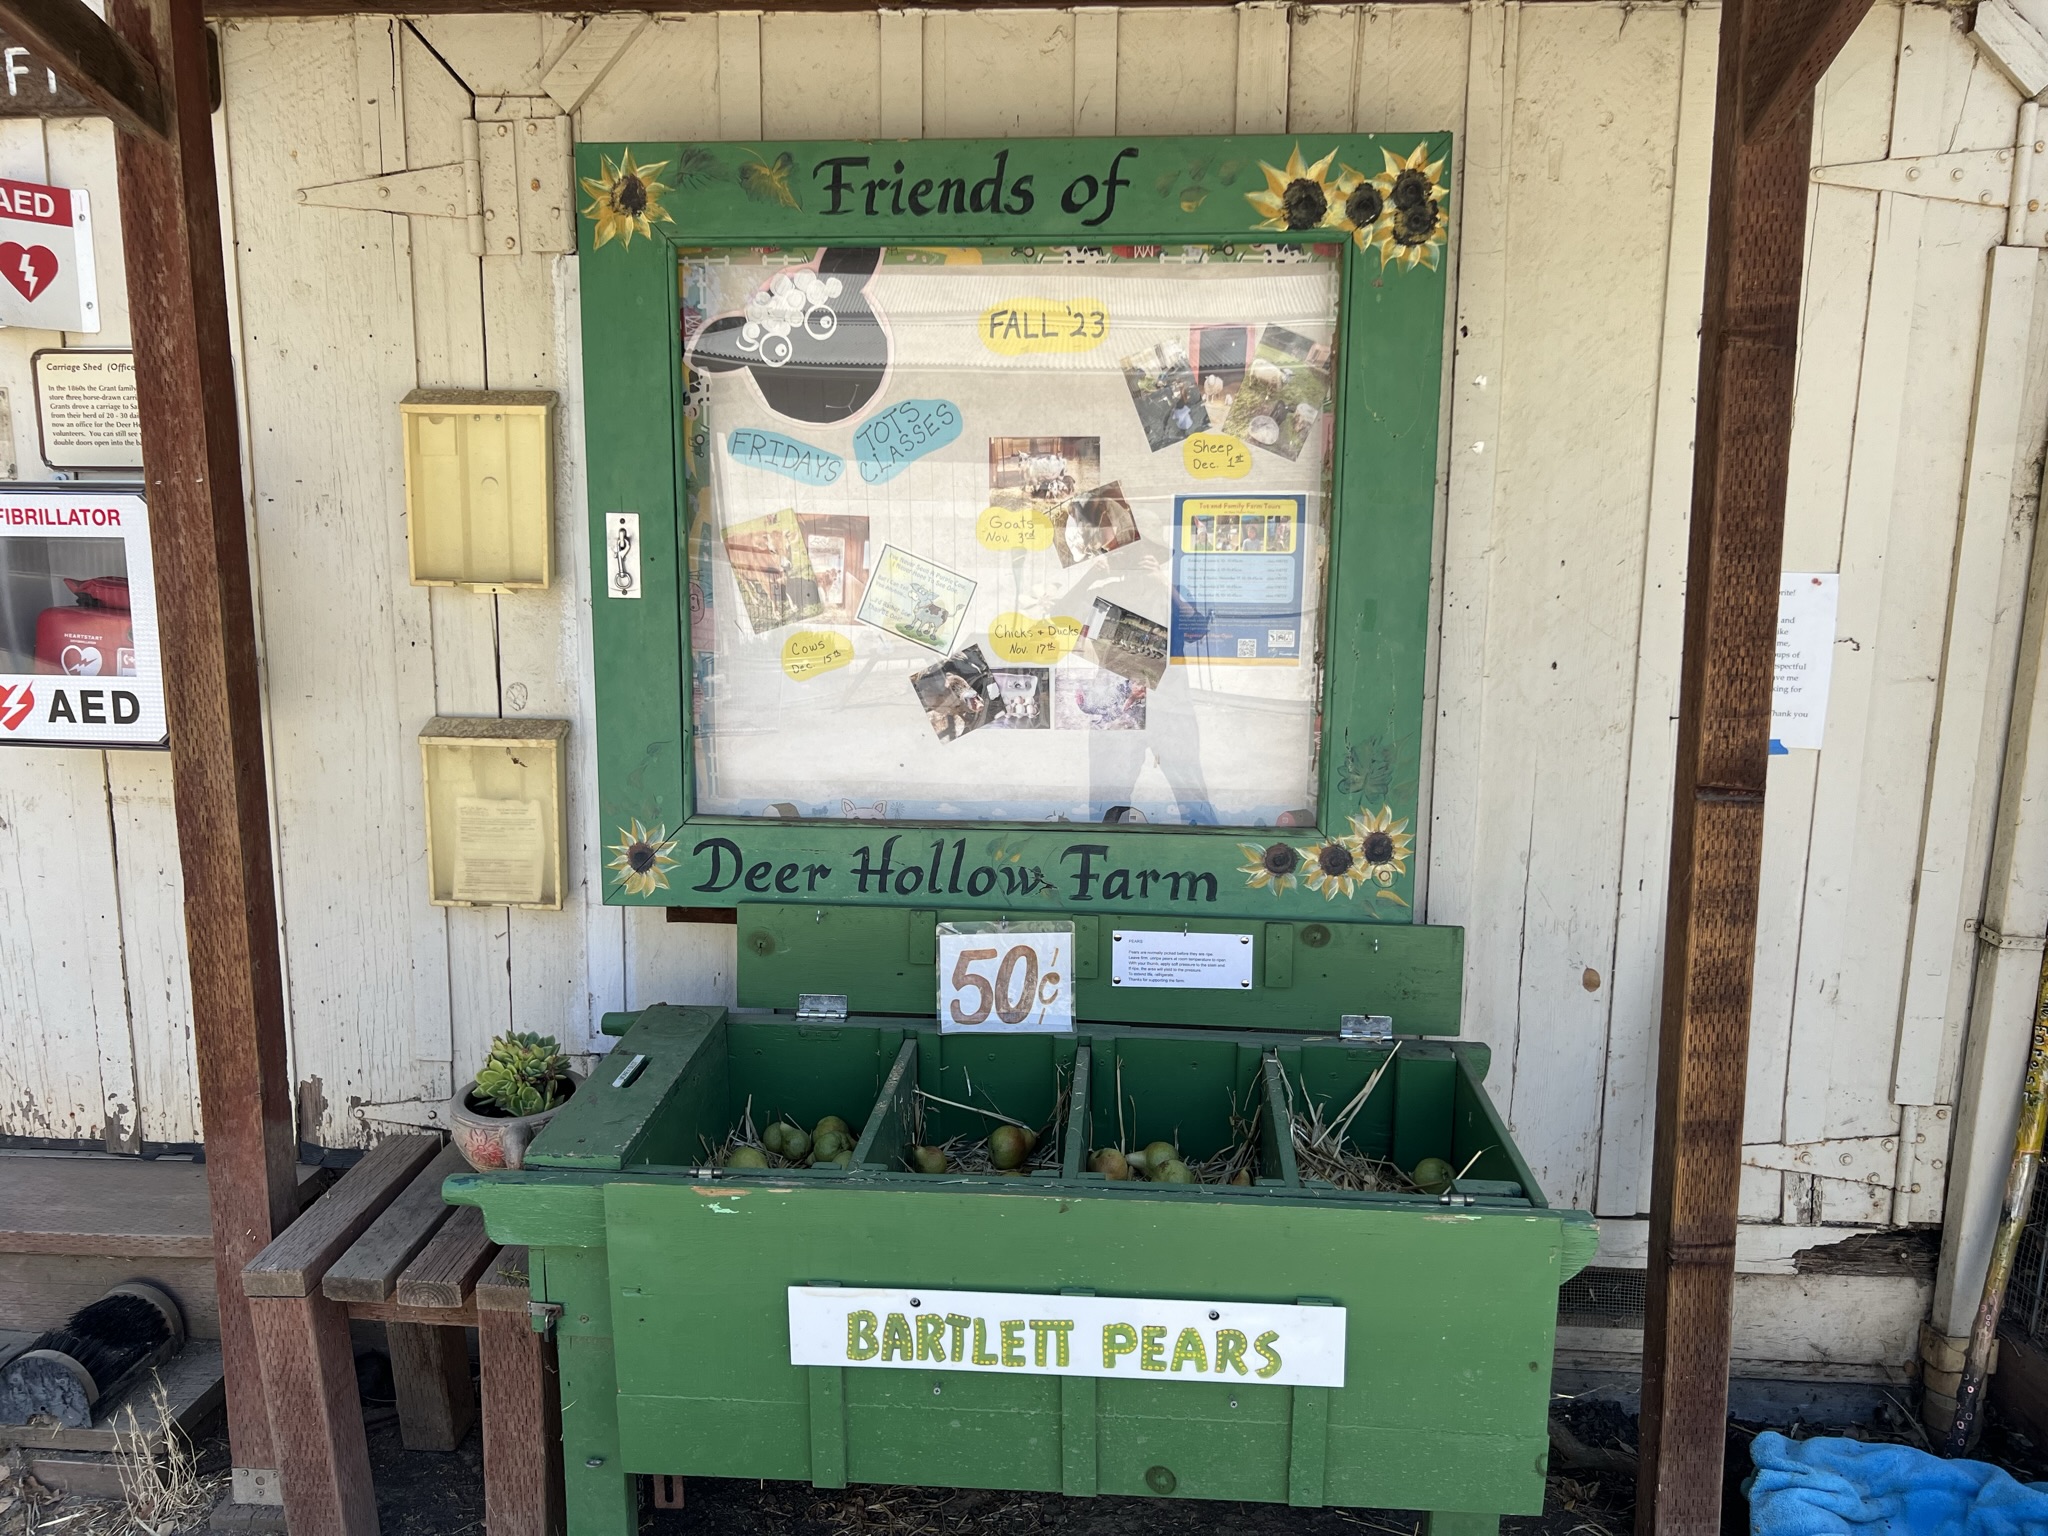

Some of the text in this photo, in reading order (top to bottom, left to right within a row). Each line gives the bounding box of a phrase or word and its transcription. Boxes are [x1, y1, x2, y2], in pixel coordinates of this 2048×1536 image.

[812, 147, 1139, 227] Friends of
[0, 187, 55, 218] AED
[989, 306, 1105, 339] FALL '23
[46, 362, 80, 373] Carriage
[83, 362, 102, 371] Shed
[96, 403, 121, 411] carriage
[856, 401, 920, 450] TOTS
[860, 403, 954, 482] CLASSES
[1193, 440, 1233, 456] Sheep
[731, 432, 842, 482] FRIDAYS
[1193, 454, 1244, 470] Dec. 1st
[1223, 502, 1244, 512] Family
[989, 515, 1034, 530] Goats
[986, 529, 1036, 544] Nov. 3rd
[1779, 589, 1796, 597] rite!
[64, 633, 103, 641] HEARTSTART
[994, 624, 1034, 639] Chicks
[1047, 625, 1079, 637] Ducks
[791, 641, 826, 656] Cows
[1009, 643, 1056, 655] Nov. 17th
[1775, 651, 1801, 660] ups of
[791, 650, 842, 674] Dec. 15th
[1790, 685, 1802, 693] for
[48, 689, 140, 725] AED
[1793, 711, 1809, 720] you
[690, 834, 1219, 902] Deer Hollow Farm
[950, 945, 1061, 1025] 50¢
[846, 1309, 1282, 1378] BARTLETT PEARS
